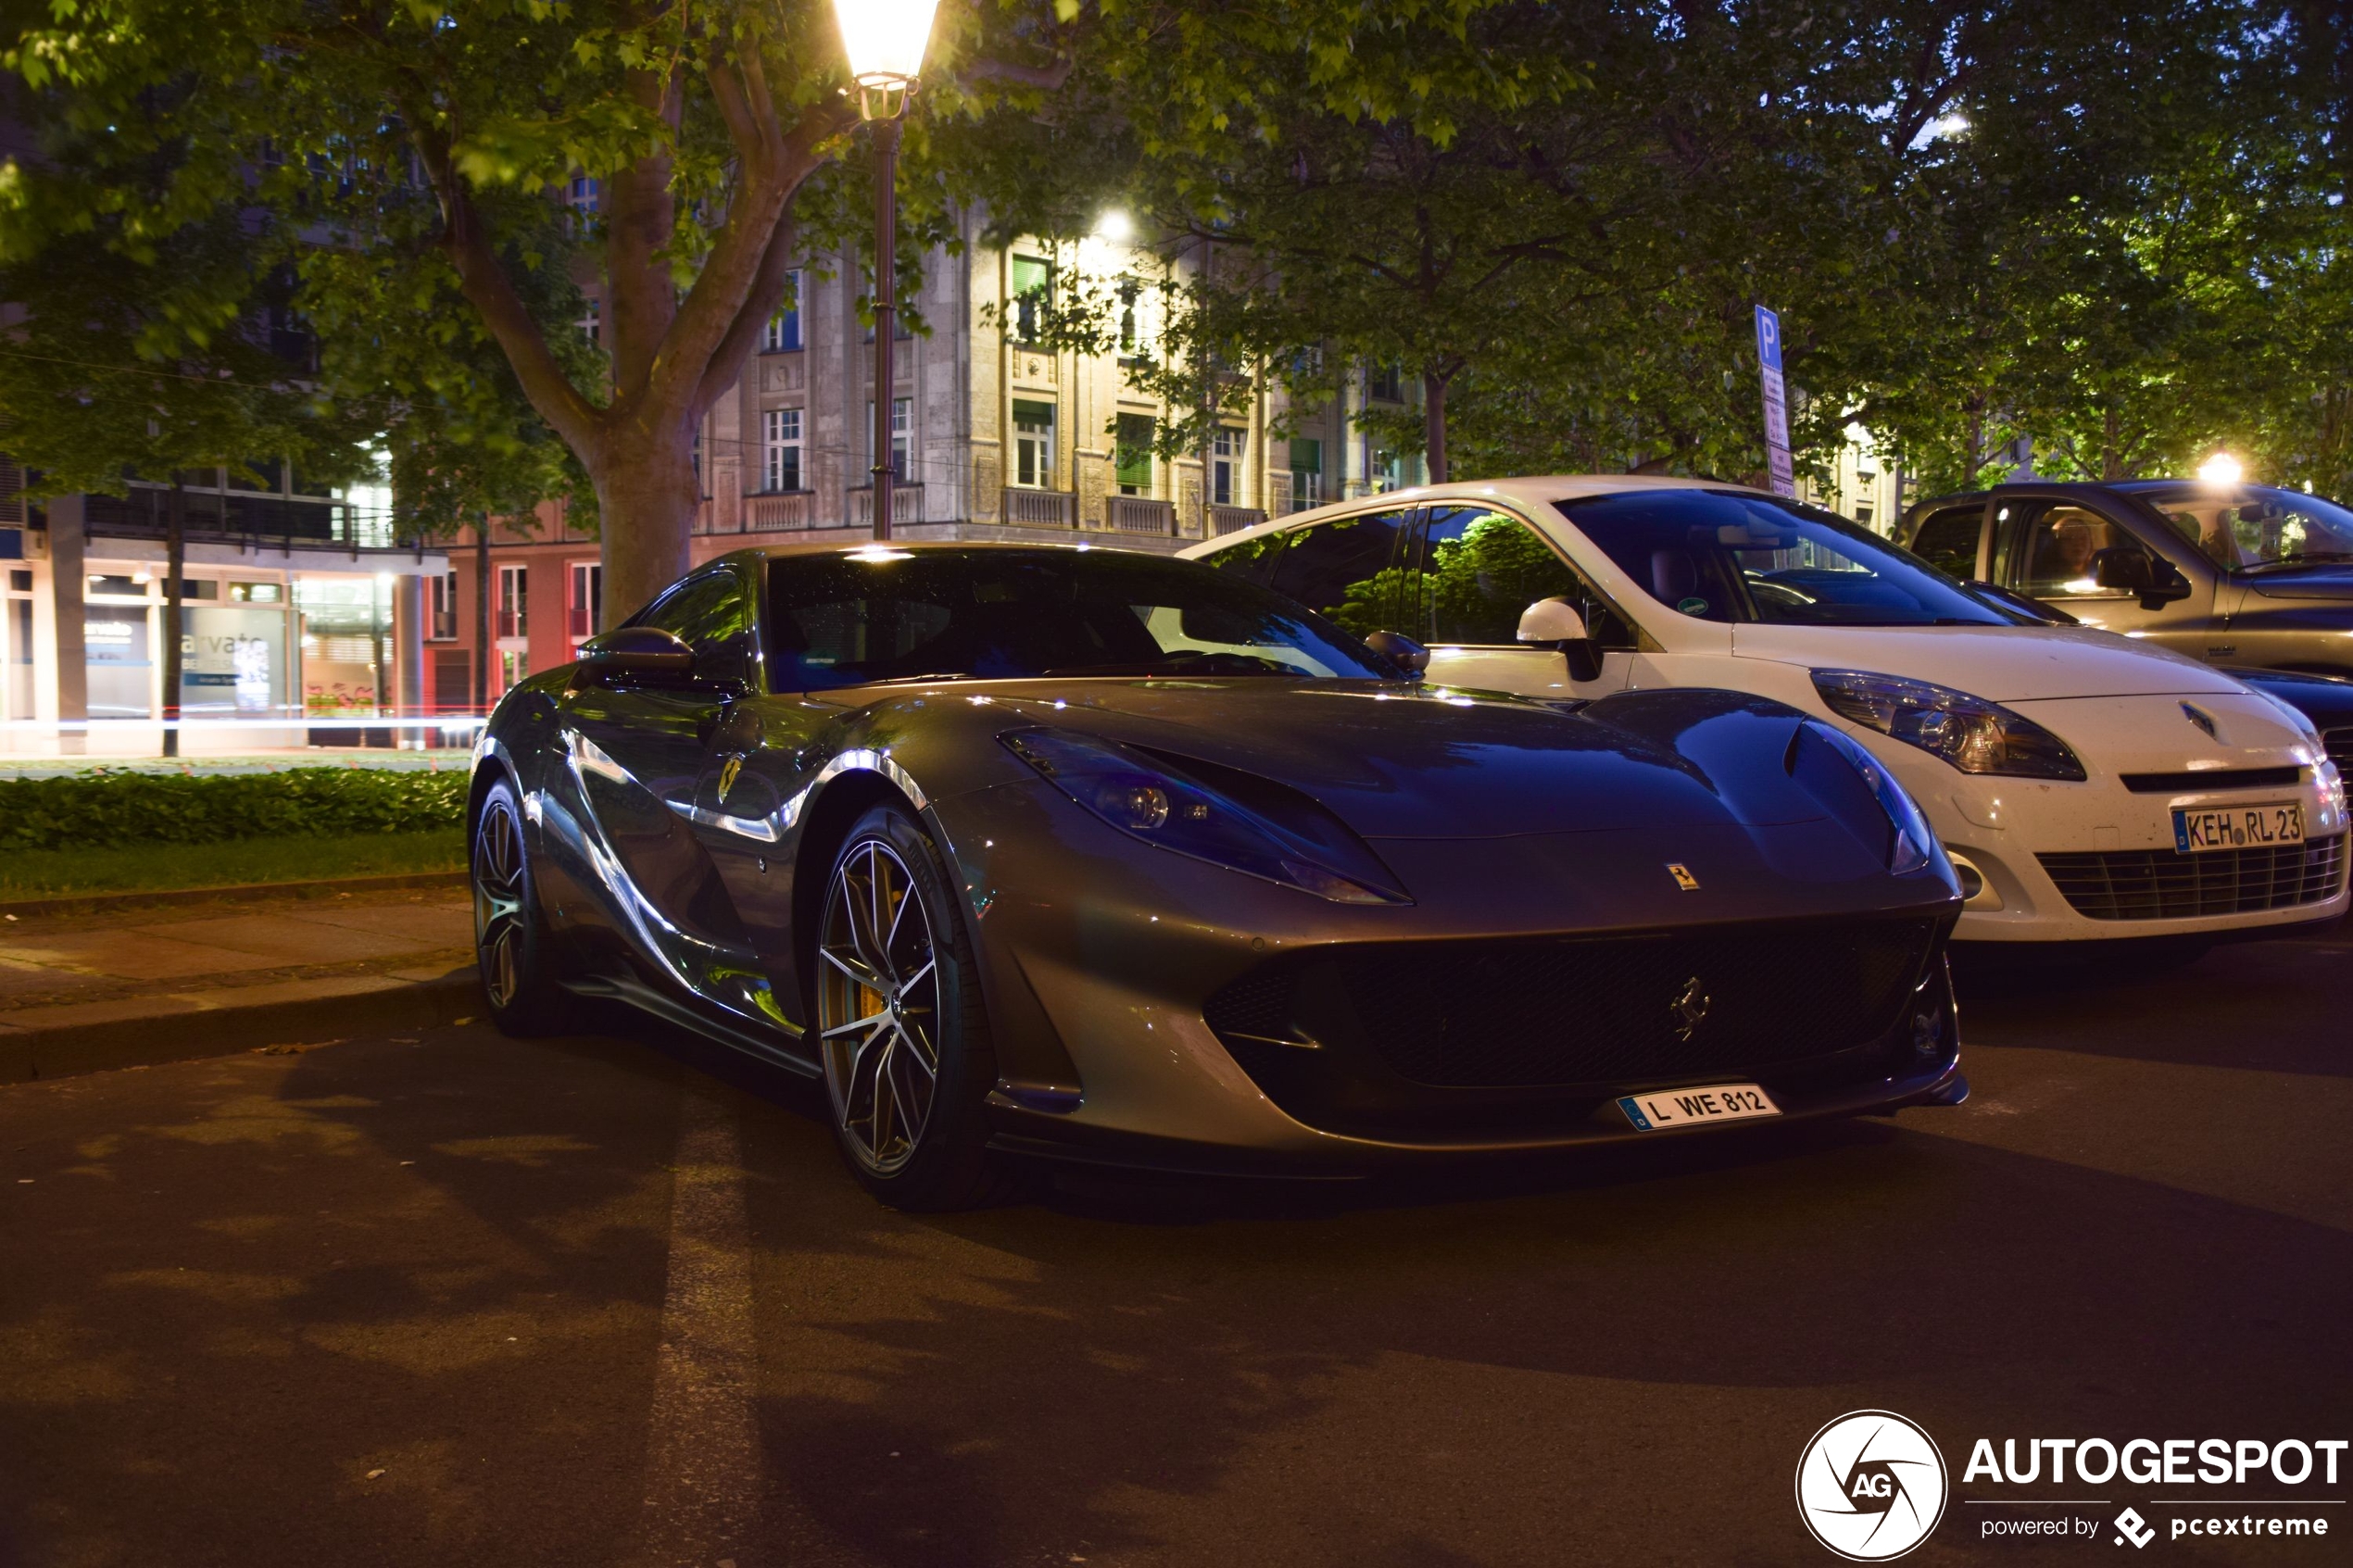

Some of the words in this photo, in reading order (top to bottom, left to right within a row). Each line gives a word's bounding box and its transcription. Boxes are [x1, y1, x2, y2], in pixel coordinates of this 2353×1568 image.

[1762, 316, 1775, 358] P
[2187, 813, 2233, 847] KEH
[2245, 810, 2273, 842] RL
[2276, 809, 2300, 841] 23
[1647, 1101, 1671, 1122] L
[1674, 1094, 1722, 1117] WE
[1721, 1091, 1767, 1112] 812
